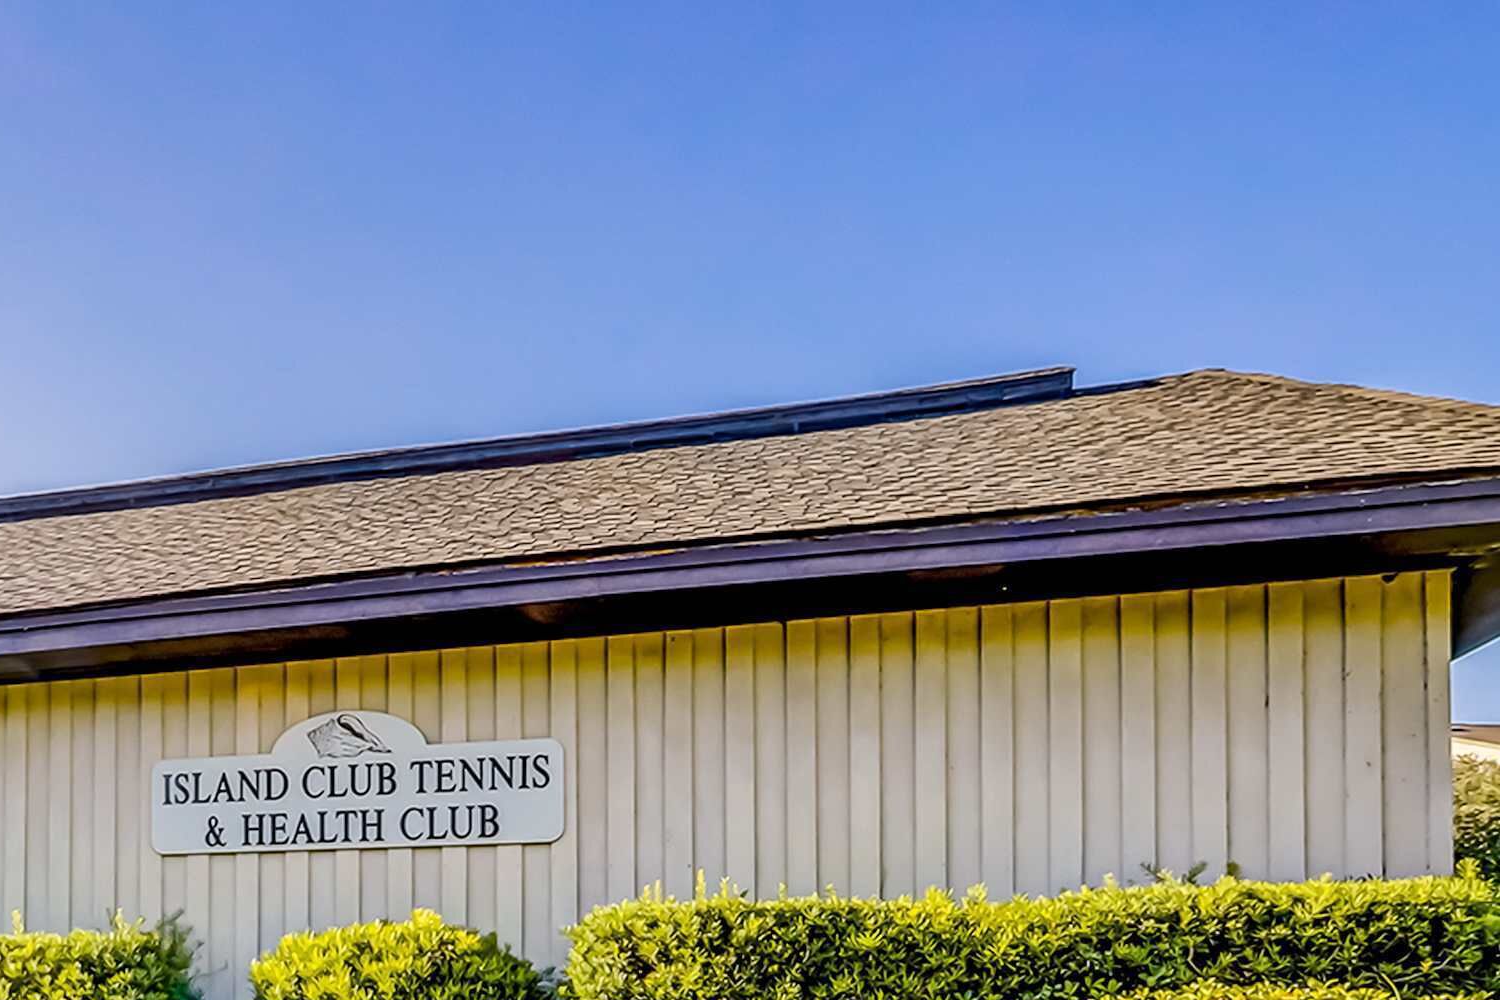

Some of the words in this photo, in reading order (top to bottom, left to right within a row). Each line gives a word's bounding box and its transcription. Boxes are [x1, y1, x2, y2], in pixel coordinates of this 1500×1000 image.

[162, 767, 289, 806] ISLAND
[301, 761, 397, 799] CLUB
[409, 753, 551, 794] TENNIS
[204, 815, 227, 848] &
[241, 808, 385, 846] HEALTH
[399, 804, 500, 841] CLUB
